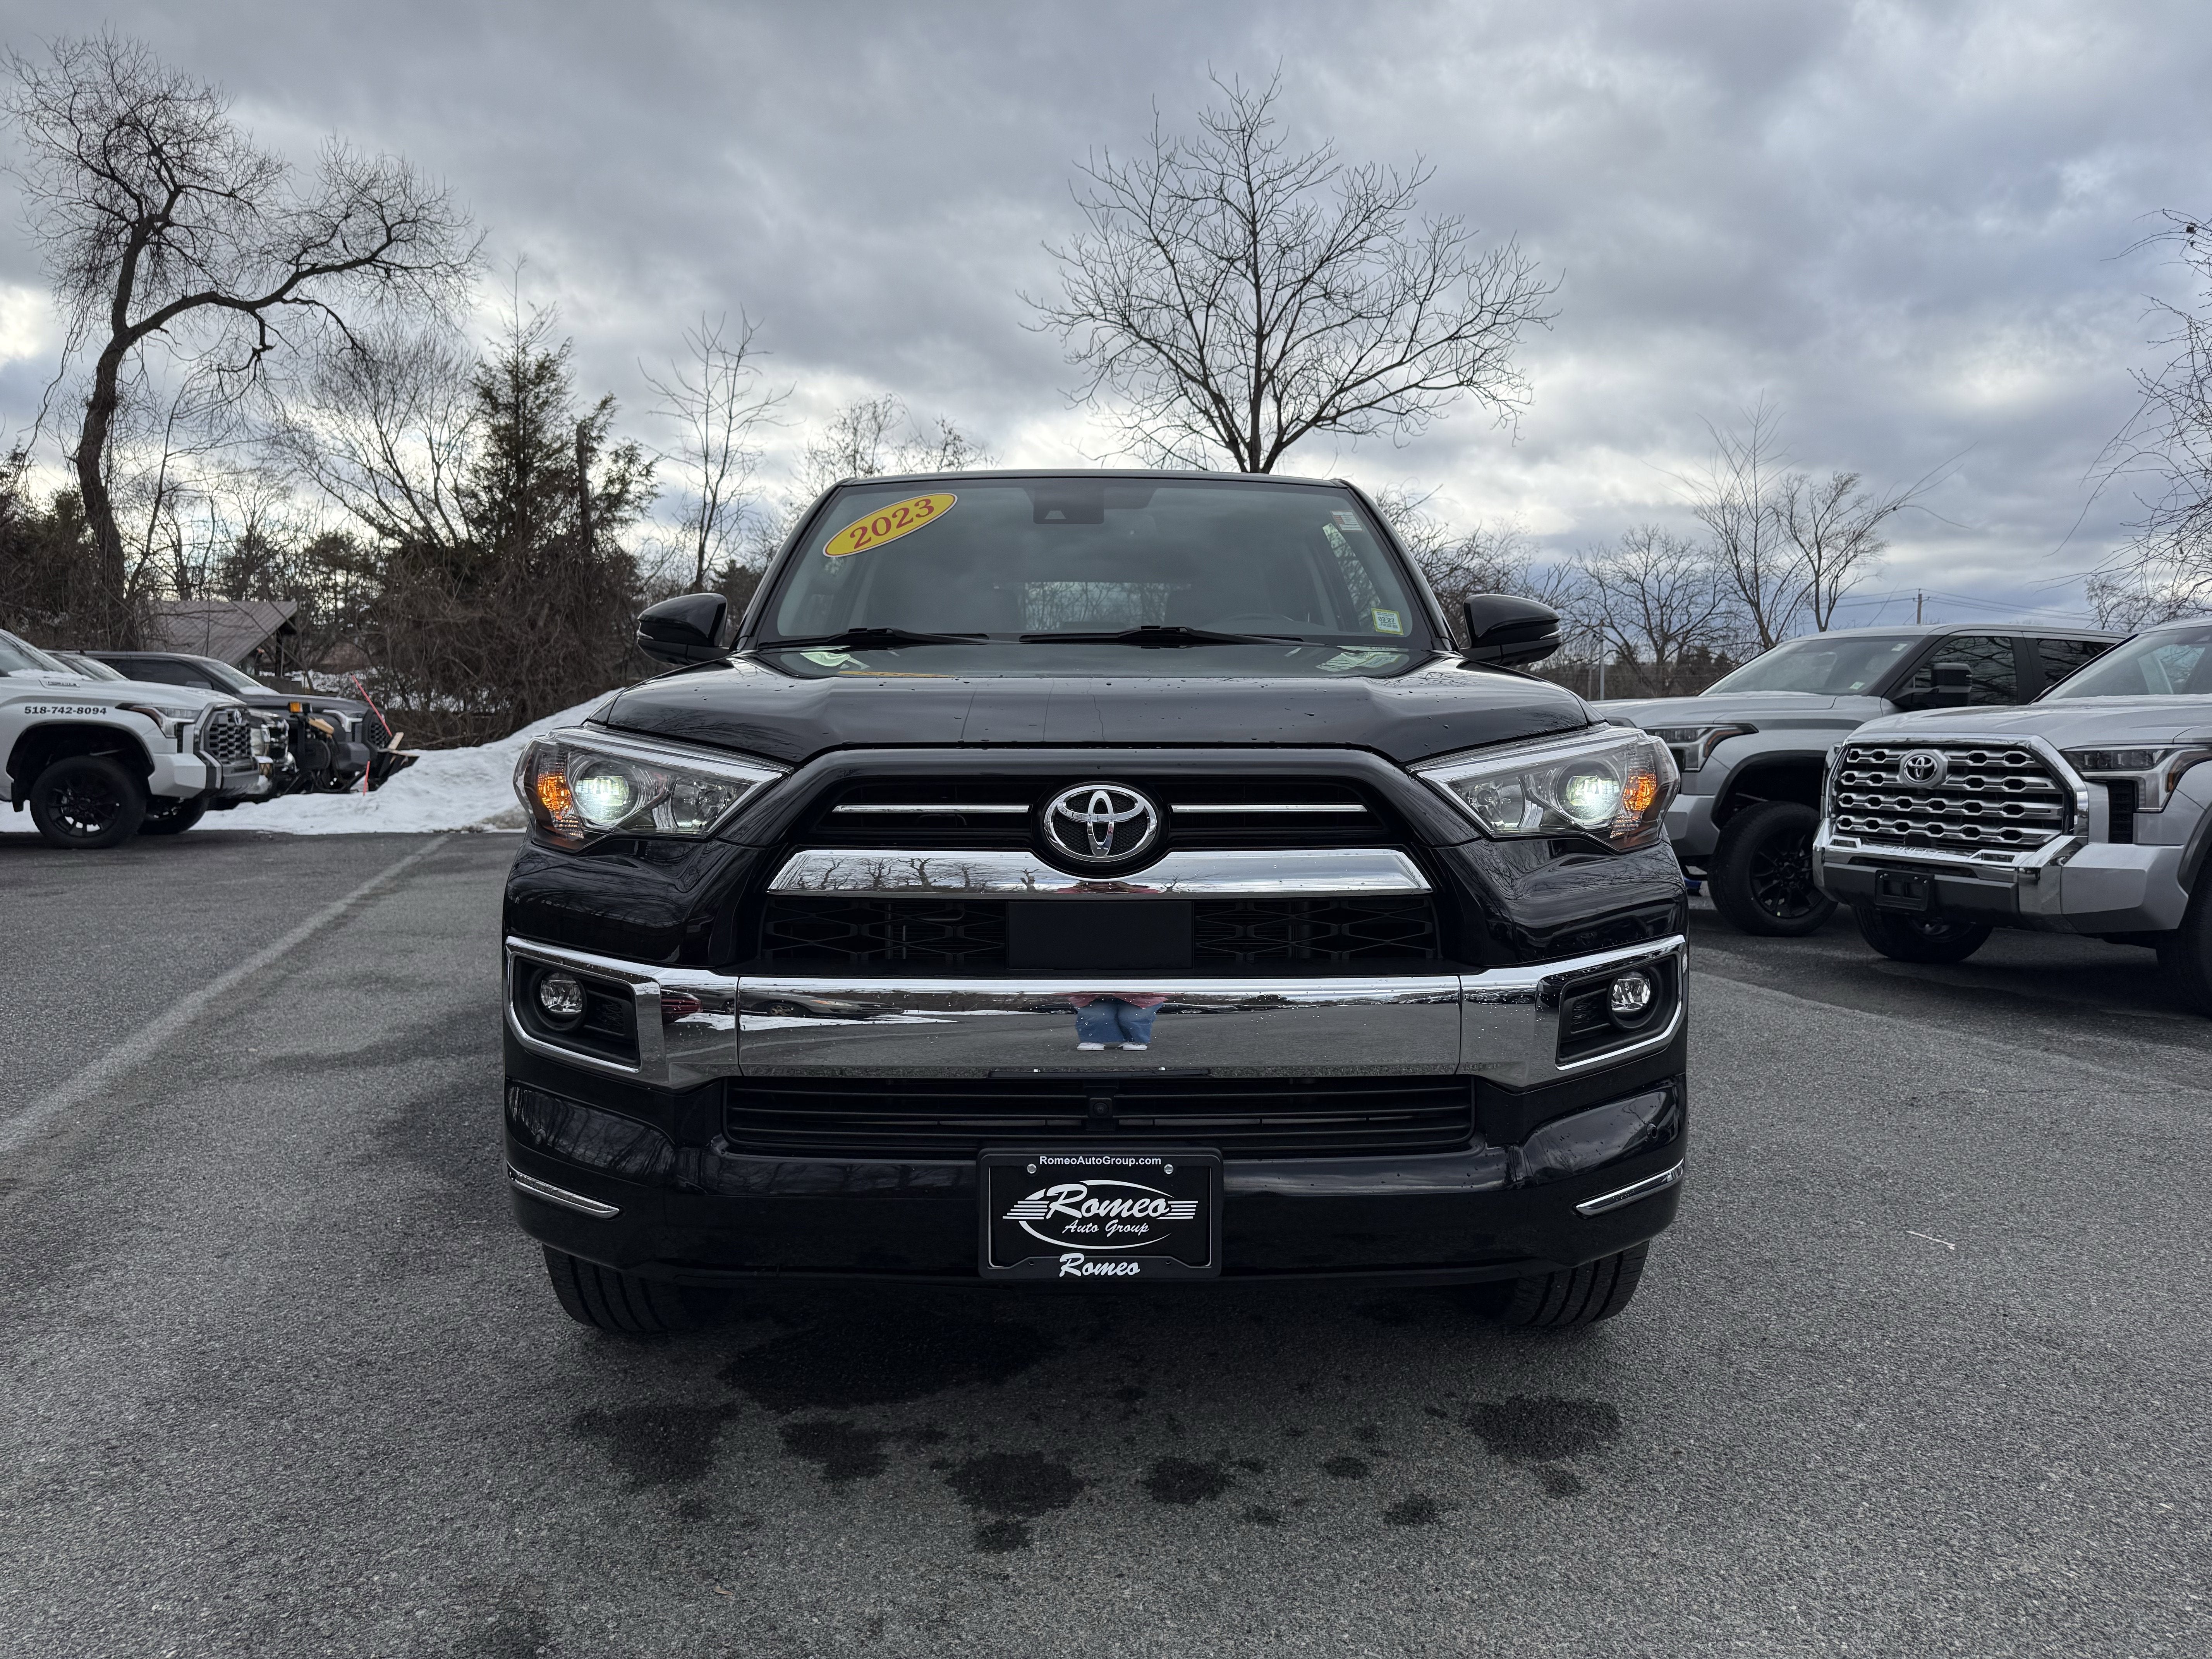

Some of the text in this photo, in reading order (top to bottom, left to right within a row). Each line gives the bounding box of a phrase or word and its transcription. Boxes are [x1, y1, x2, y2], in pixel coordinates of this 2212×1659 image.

[850, 498, 935, 549] 2023
[24, 706, 106, 715] 518-742-8094
[1039, 1156, 1162, 1166] RomeoAutoGroup.com
[1046, 1183, 1170, 1219] Romeo
[1062, 1219, 1150, 1237] Auto Group
[1059, 1252, 1140, 1277] Romeo
